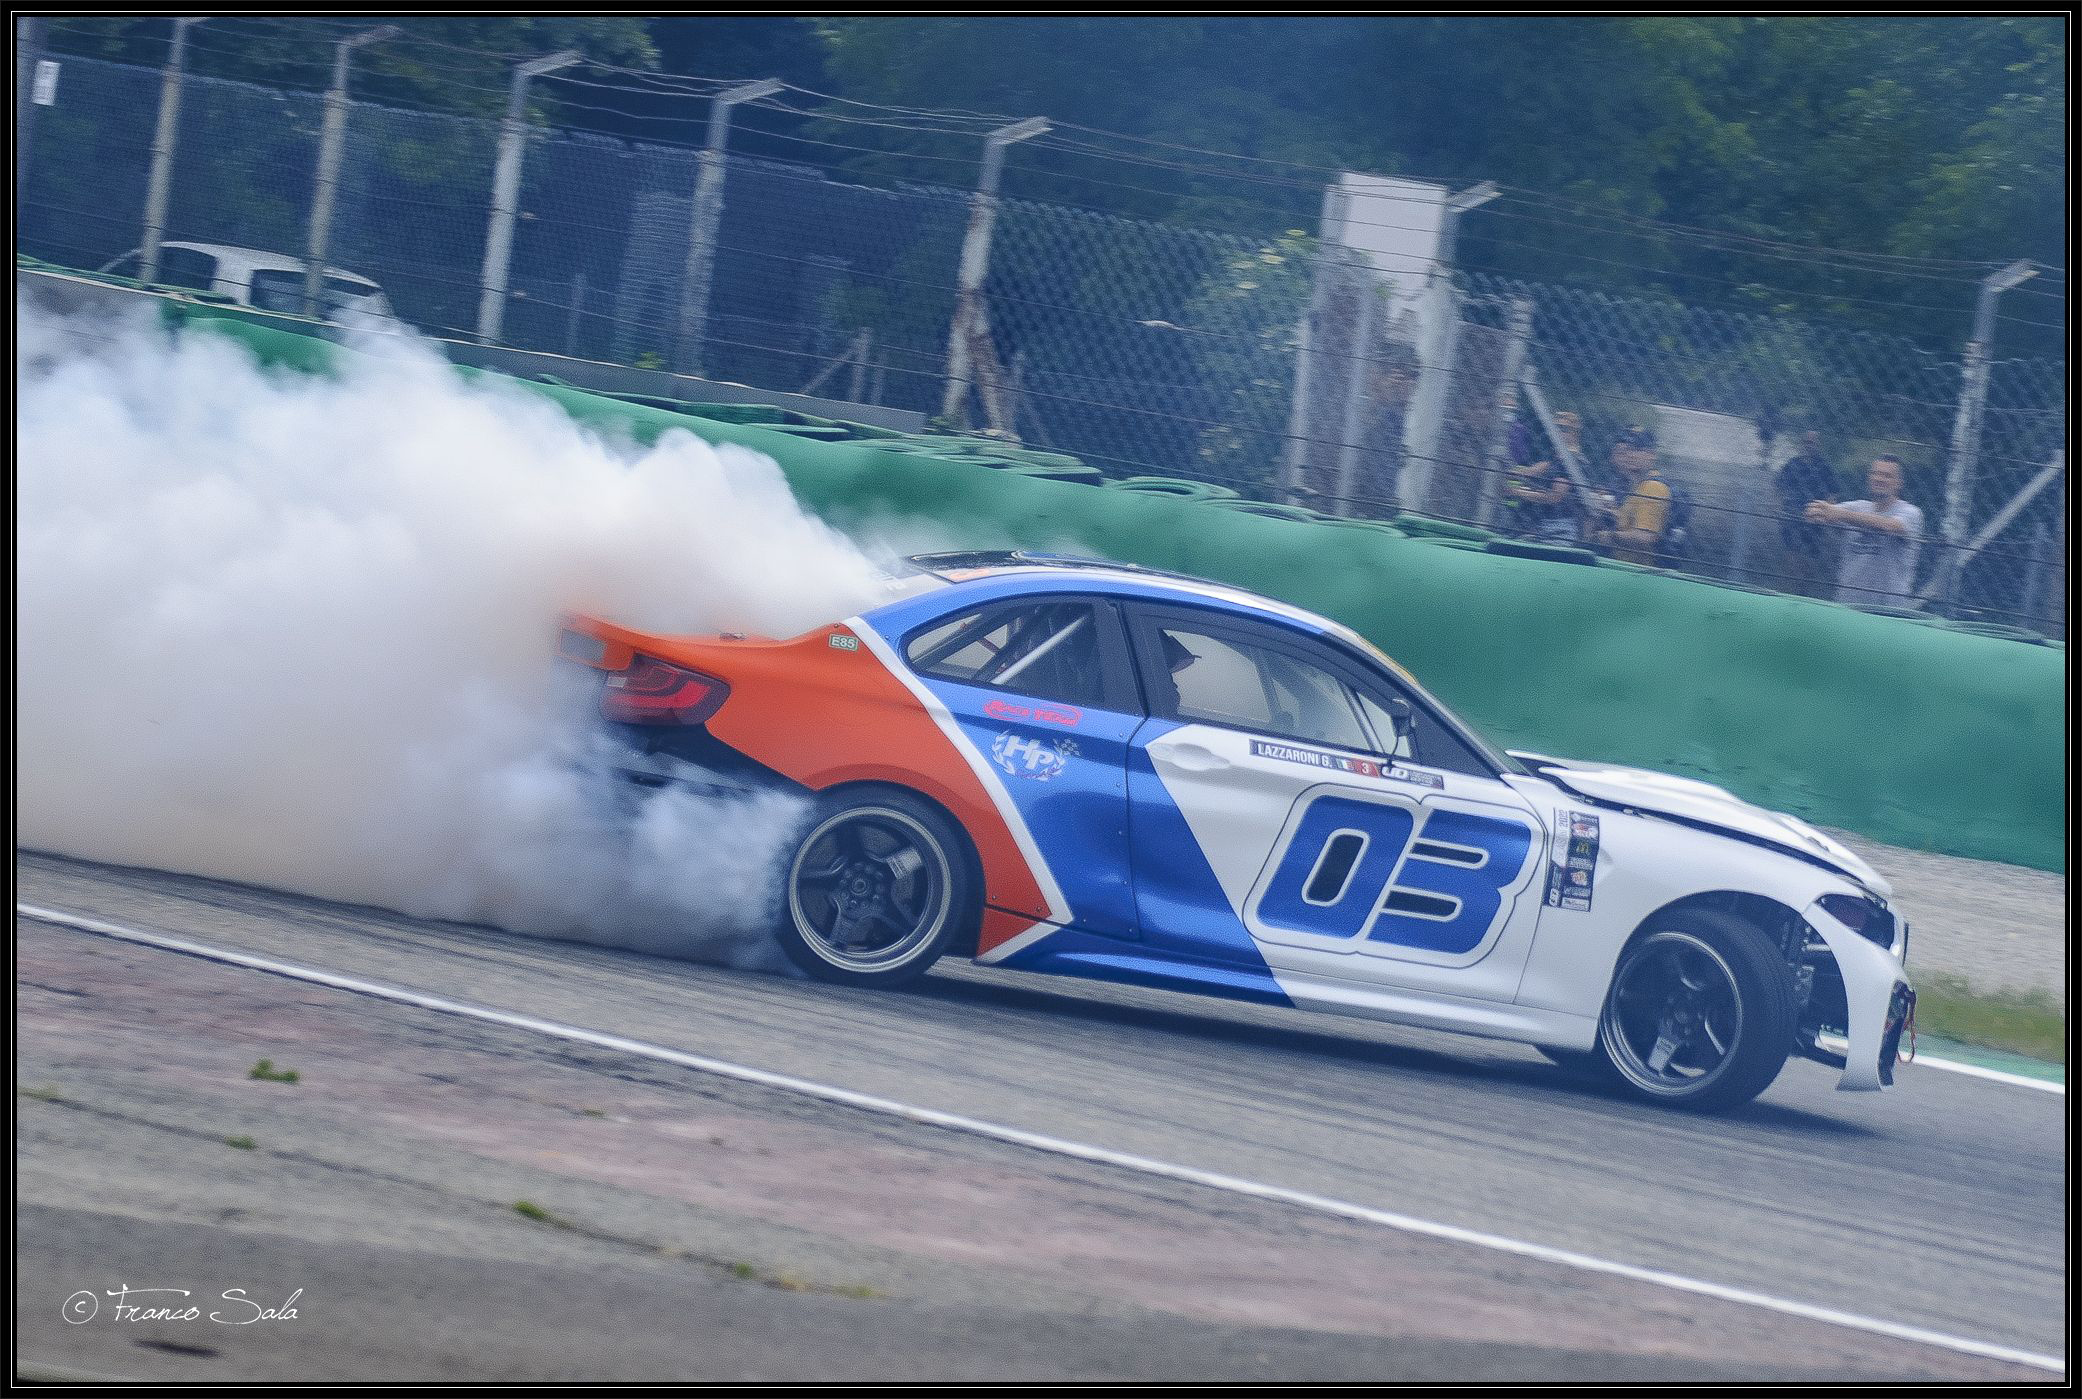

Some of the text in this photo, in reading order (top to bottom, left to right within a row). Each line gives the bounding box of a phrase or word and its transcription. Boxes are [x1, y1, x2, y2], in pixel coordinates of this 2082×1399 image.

[831, 636, 855, 649] E85
[1003, 735, 1055, 770] HP
[1257, 743, 1319, 764] LAZZARONI
[1361, 762, 1369, 774] 3
[1255, 793, 1533, 955] 03
